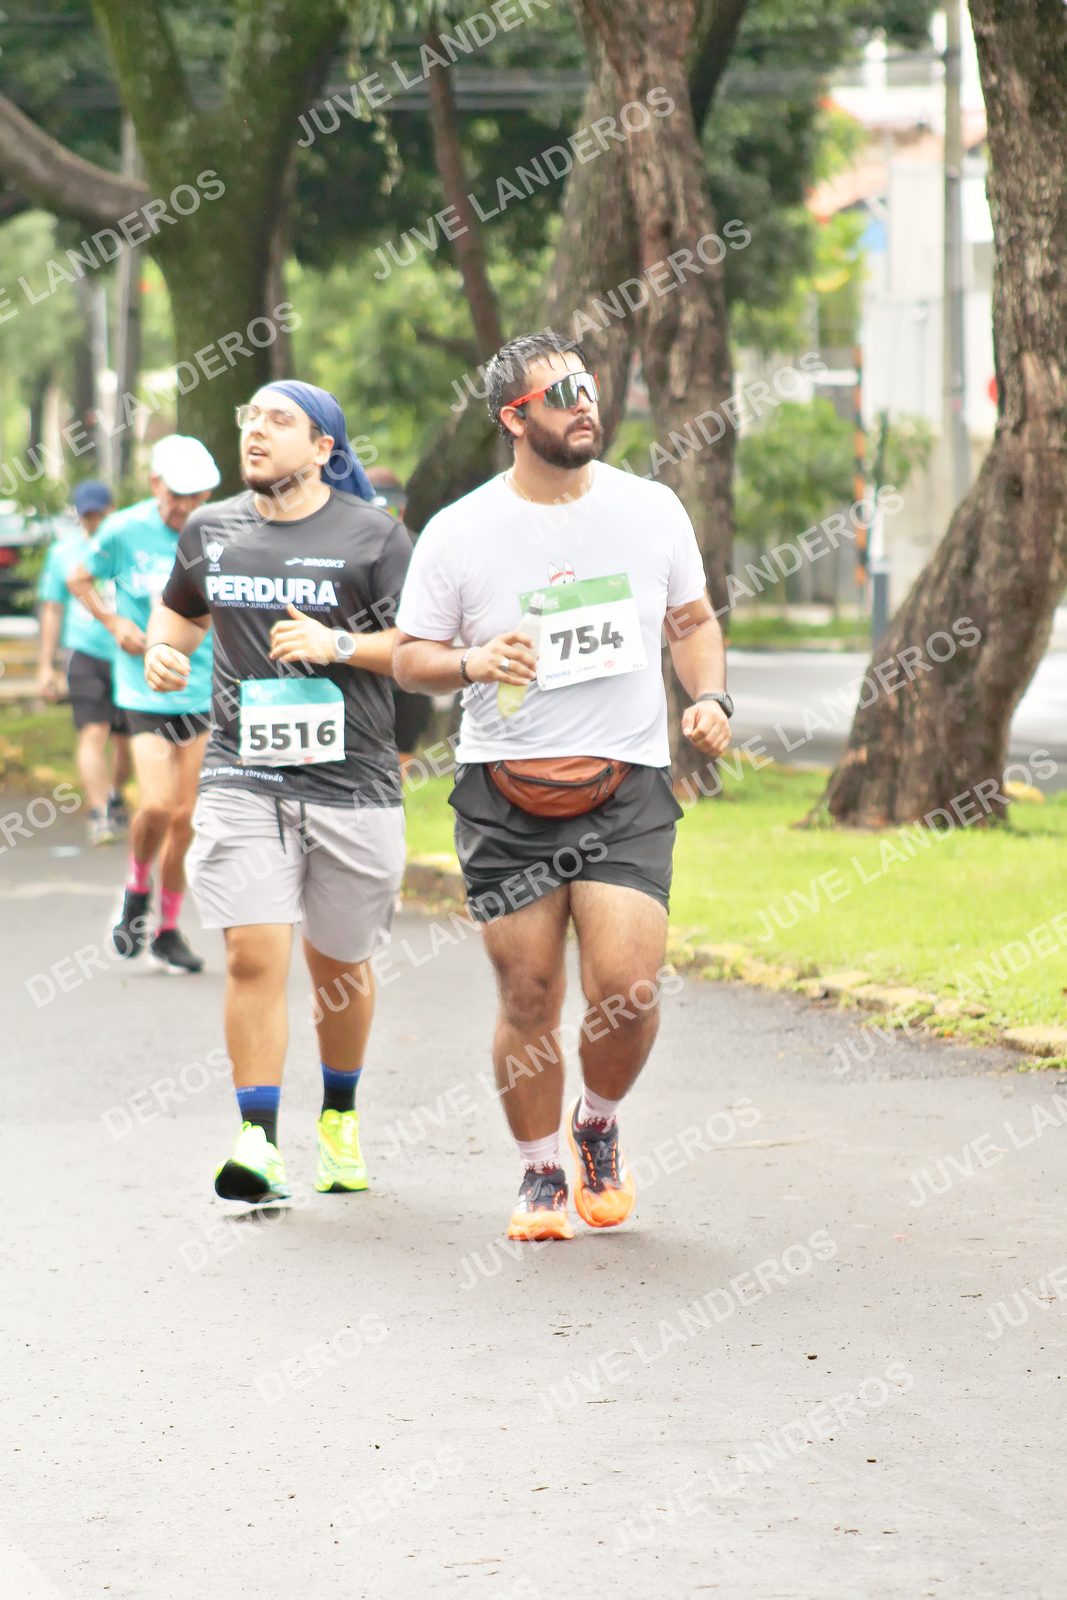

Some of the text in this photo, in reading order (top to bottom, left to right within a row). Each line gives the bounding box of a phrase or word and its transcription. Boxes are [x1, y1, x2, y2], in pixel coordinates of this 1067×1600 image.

[303, 557, 346, 568] BROOKS
[205, 575, 339, 606] PERDURA
[550, 621, 624, 661] 754
[249, 720, 337, 751] 5516
[245, 769, 284, 782] corriendo
